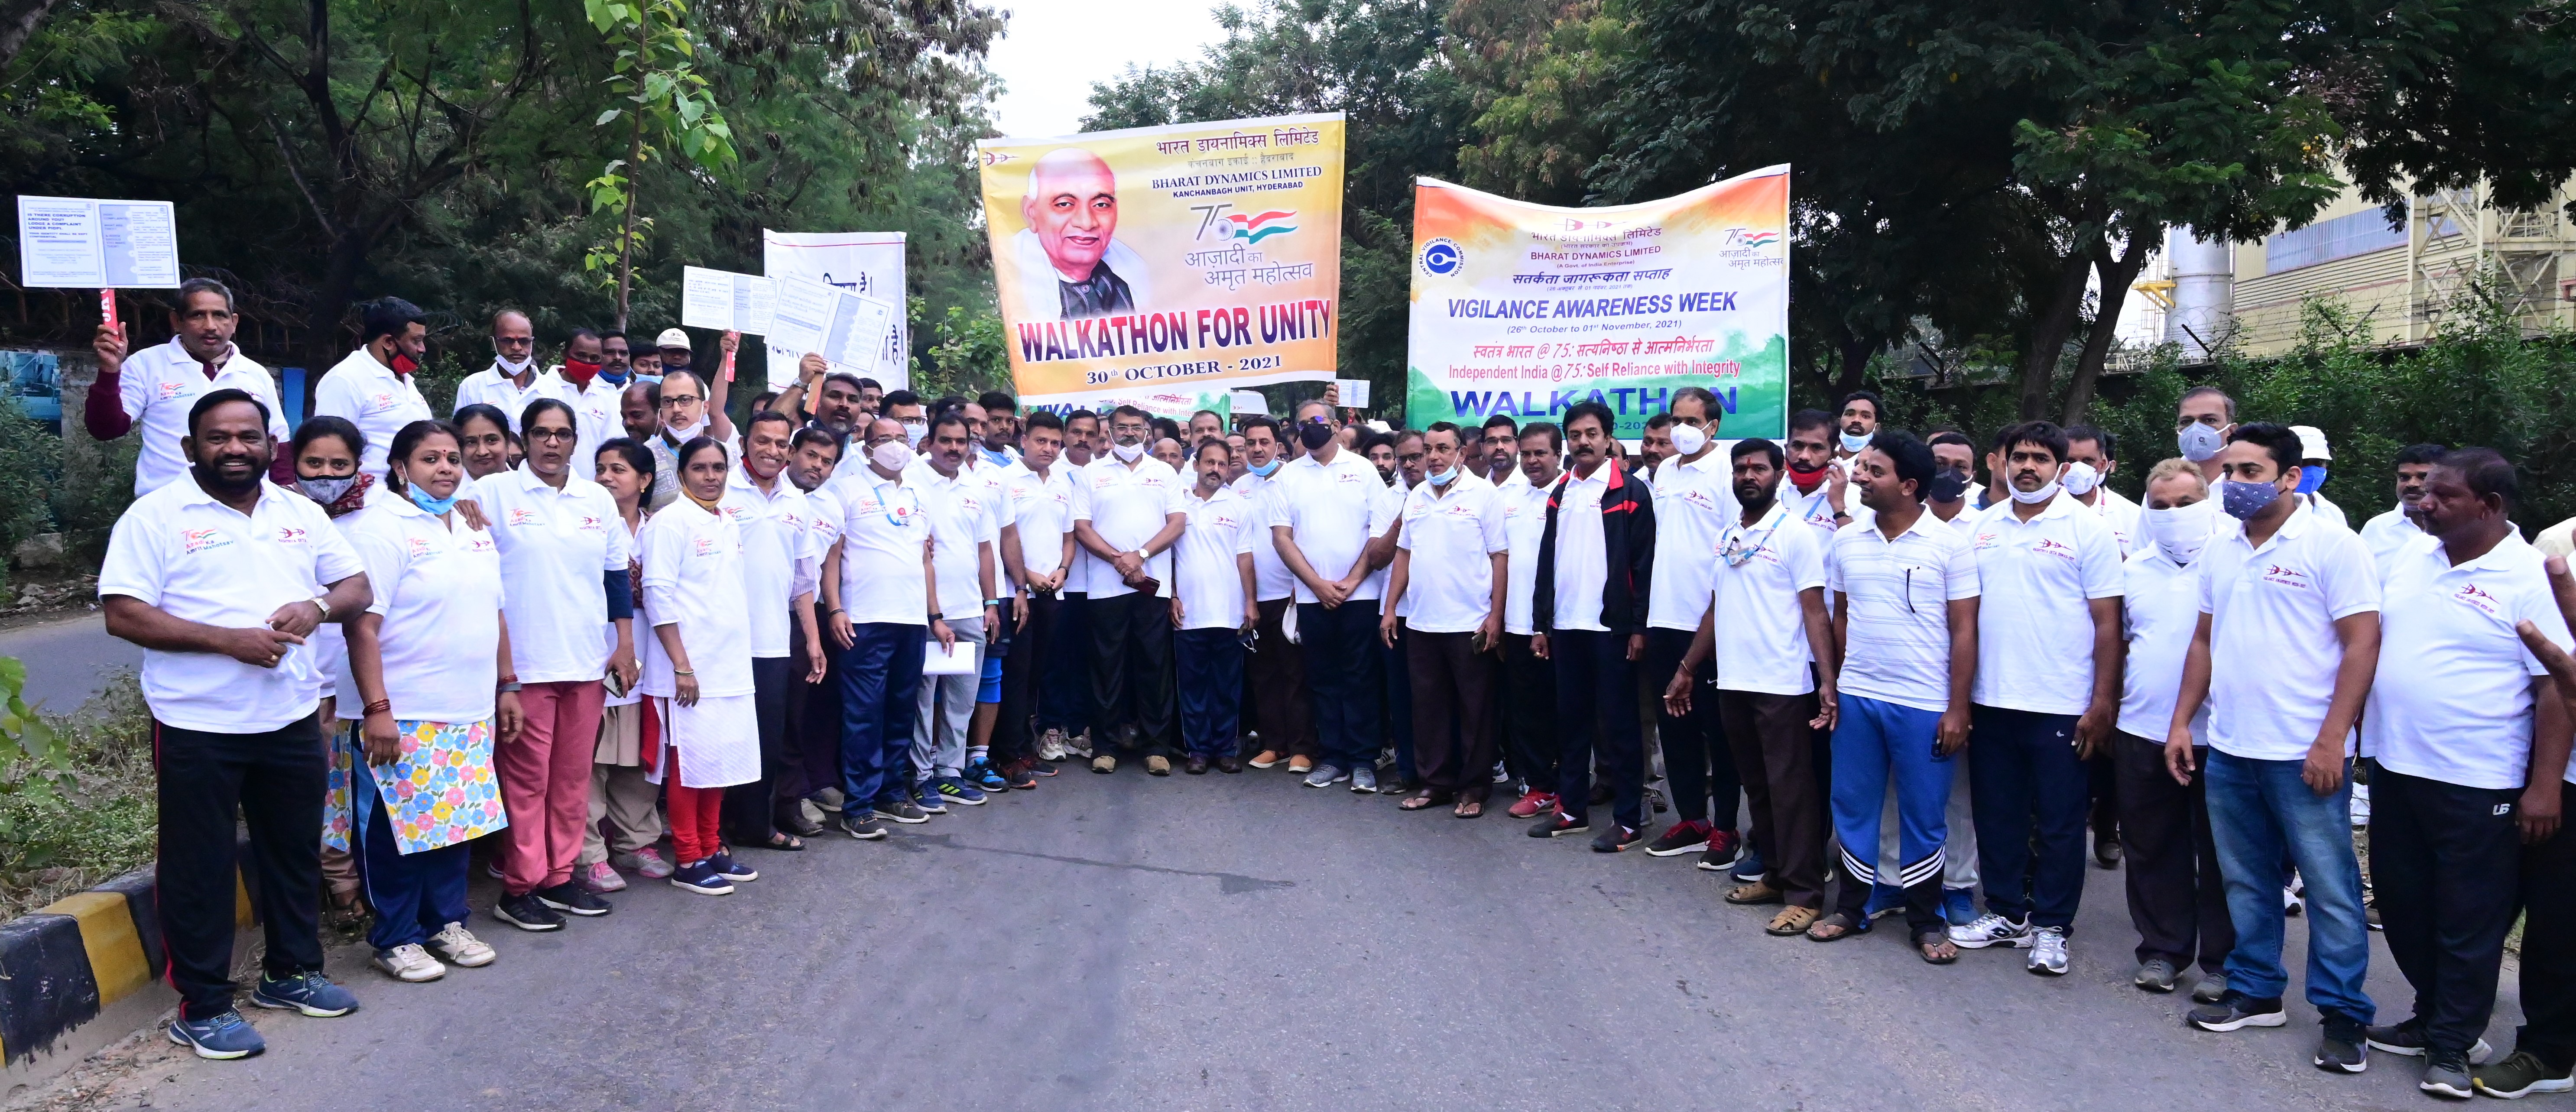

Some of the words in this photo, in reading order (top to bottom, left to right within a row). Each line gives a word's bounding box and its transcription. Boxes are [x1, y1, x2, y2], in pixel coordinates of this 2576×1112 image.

[1156, 140, 1189, 155] भारत
[1197, 132, 1266, 152] डायनामिक्स
[1274, 127, 1318, 147] लिमिटेड
[1227, 154, 1248, 166] इकाई
[1260, 152, 1294, 164] हैदराबाद
[1152, 176, 1200, 189] BHARAT
[1205, 170, 1268, 185] DYNAMICS
[1272, 166, 1322, 179] LIMITED
[1173, 187, 1233, 198] KANCHANBAGH
[1256, 181, 1303, 191] HYDERABAD
[1623, 227, 1662, 240] लिमिटेड
[1421, 238, 1452, 250] VIGILANCE
[1531, 252, 1569, 260] BHARAT
[1572, 250, 1621, 260] DYNAMICS
[1625, 245, 1661, 257] LIMITED
[1247, 252, 1262, 263] का
[1419, 253, 1432, 277] CENTRAL
[1450, 243, 1464, 277] COMMISSION
[1729, 259, 1750, 270] अमृत
[1205, 269, 1246, 291] अमृत
[1252, 261, 1313, 285] महोत्सव
[1512, 271, 1561, 284] सतर्कता
[1563, 271, 1631, 284] जागरूकता
[1633, 268, 1673, 280] सप्ताह
[1447, 299, 1549, 318] VIGILANCE
[1553, 295, 1673, 318] AWARENESS
[1679, 291, 1738, 312] WEEK
[1018, 311, 1188, 363] WALKATHON
[1196, 307, 1252, 348] FOR
[1259, 300, 1330, 343] UNITY
[1530, 324, 1567, 334] October
[1601, 321, 1652, 331] November,
[1655, 320, 1682, 329] 2021)
[1473, 341, 1503, 359] स्वतंत्र
[1506, 345, 1534, 359] भारत
[1537, 345, 1551, 357] @
[1577, 339, 1629, 357] सत्यनिष्ठा
[1632, 339, 1644, 354] से
[1646, 336, 1715, 354] आत्मनिर्भरता
[1126, 360, 1221, 381] OCTOBER
[1239, 355, 1282, 371] 2021
[1449, 364, 1518, 381] Independent
[1520, 363, 1548, 379] India
[1587, 364, 1609, 378] Self
[1612, 362, 1661, 378] Reliance
[1664, 360, 1688, 375] with
[1691, 359, 1741, 379] Integrity
[1132, 400, 1161, 413] Reliance
[1162, 406, 1177, 416] with
[1450, 386, 1737, 417] WALKATHN
[186, 540, 204, 549] Azadi
[186, 546, 202, 555] Amrit
[203, 540, 234, 550] Mahotsav
